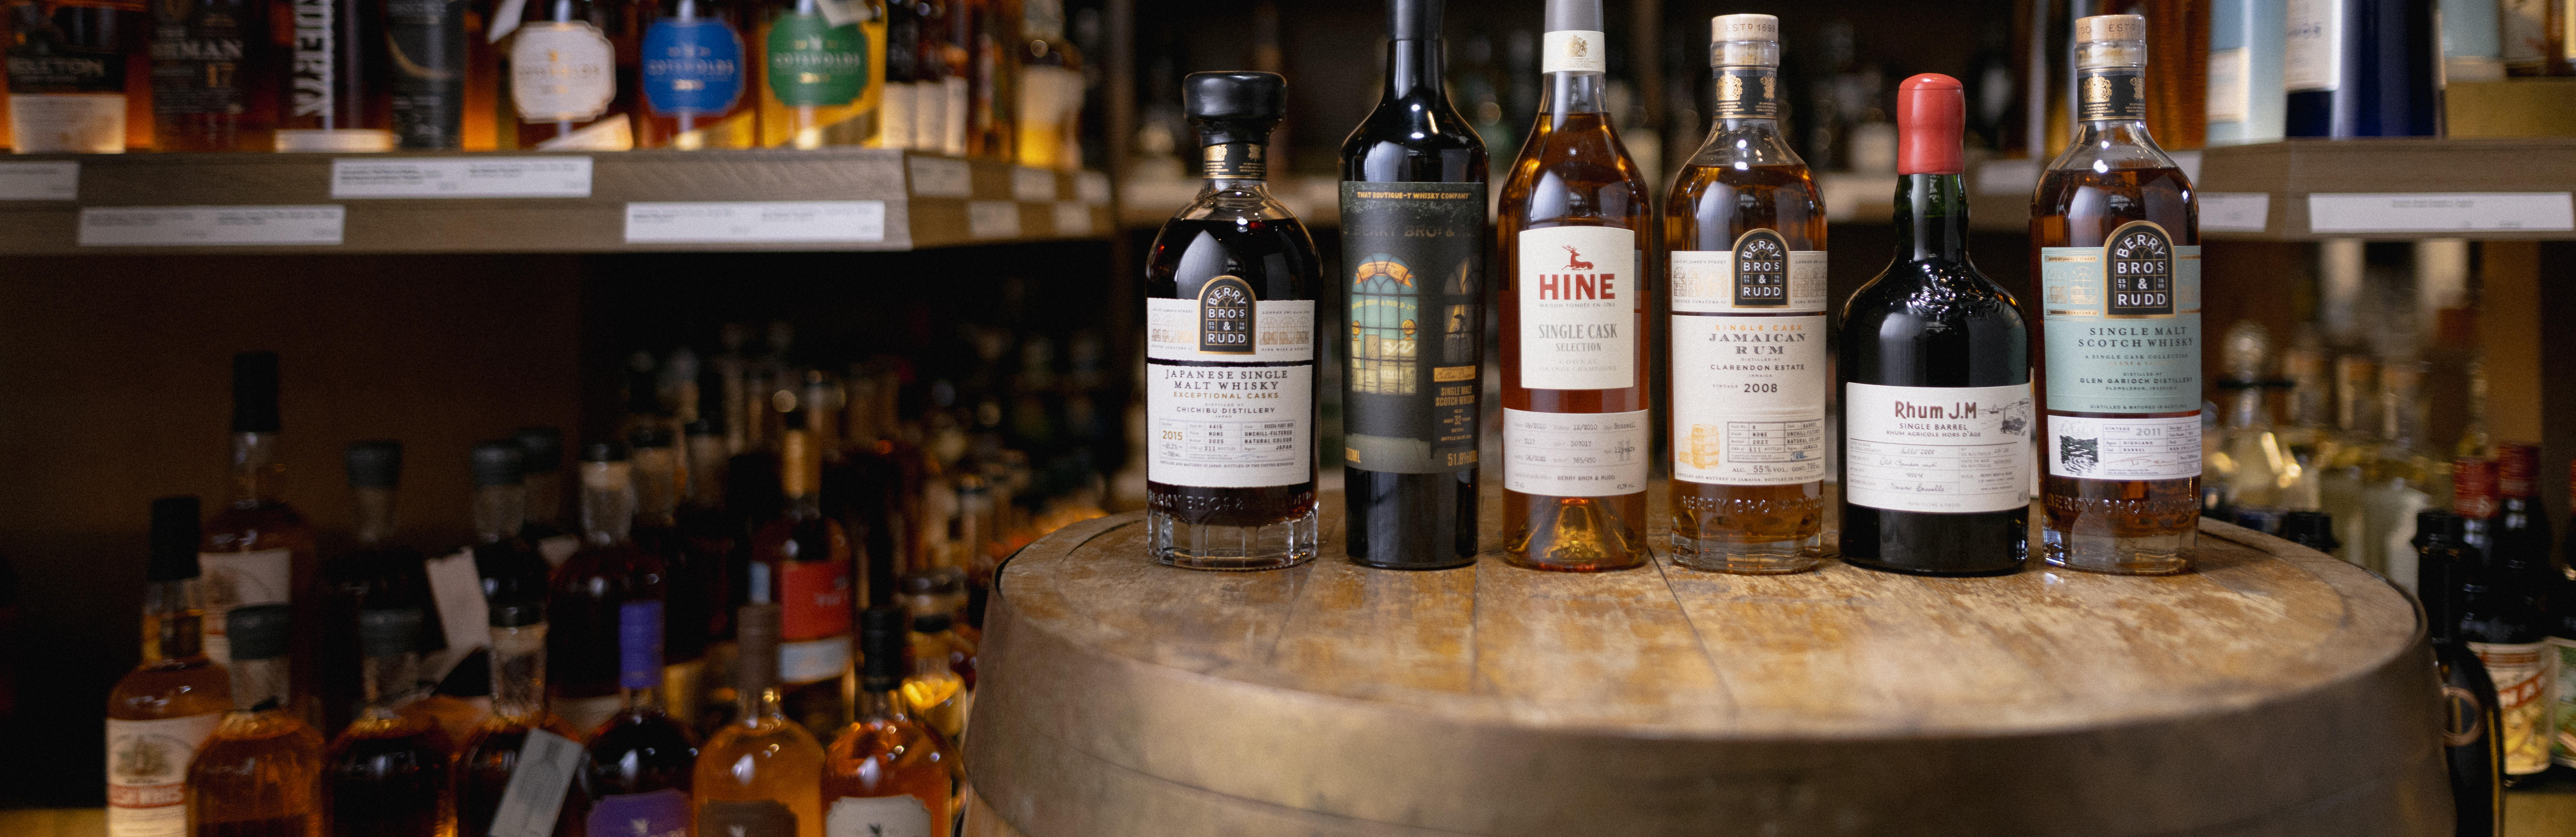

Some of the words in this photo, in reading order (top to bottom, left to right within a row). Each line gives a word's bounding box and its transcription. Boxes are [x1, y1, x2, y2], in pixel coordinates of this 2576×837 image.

[1757, 24, 1776, 32] 1698
[1446, 228, 1455, 237] &
[1743, 240, 1781, 259] BERRY
[2116, 234, 2165, 258] BERRY
[1759, 275, 1767, 284] &
[2138, 278, 2148, 289] &
[1540, 273, 1616, 300] HINE
[1208, 287, 1247, 306] BERRY
[1744, 287, 1781, 297] RUDD
[2118, 293, 2166, 306] RUDD
[1223, 321, 1231, 331] &
[1539, 324, 1582, 339] SINGLE
[1588, 323, 1618, 338] CASK
[2090, 328, 2149, 336] SINGLE
[2154, 326, 2187, 335] MALT
[1208, 333, 1246, 343] RUDD
[1709, 332, 1806, 342] JAMAICAN
[1556, 342, 1602, 352] SELECTION
[2078, 339, 2142, 347] SCOTCH
[2147, 338, 2193, 347] WHISKY
[1735, 345, 1785, 355] RUM
[1165, 369, 1234, 379] JAPANESE
[1241, 370, 1288, 379] SINGLE
[1174, 380, 1211, 390] MALT
[1218, 381, 1279, 390] WHISKY
[1744, 383, 1778, 393] 2008
[1441, 386, 1460, 396] SINGLE
[1461, 385, 1472, 395] MALT
[1435, 396, 1458, 407] SCOTCH
[1459, 395, 1475, 405] WHISKY
[1895, 400, 1943, 419] Rhum
[1949, 401, 1977, 419] J.M
[1454, 415, 1462, 425] 32
[1614, 421, 1636, 430] Bonneuil
[1162, 430, 1183, 441] 2015
[2136, 428, 2161, 436] 2011
[1754, 464, 1772, 473] 55%
